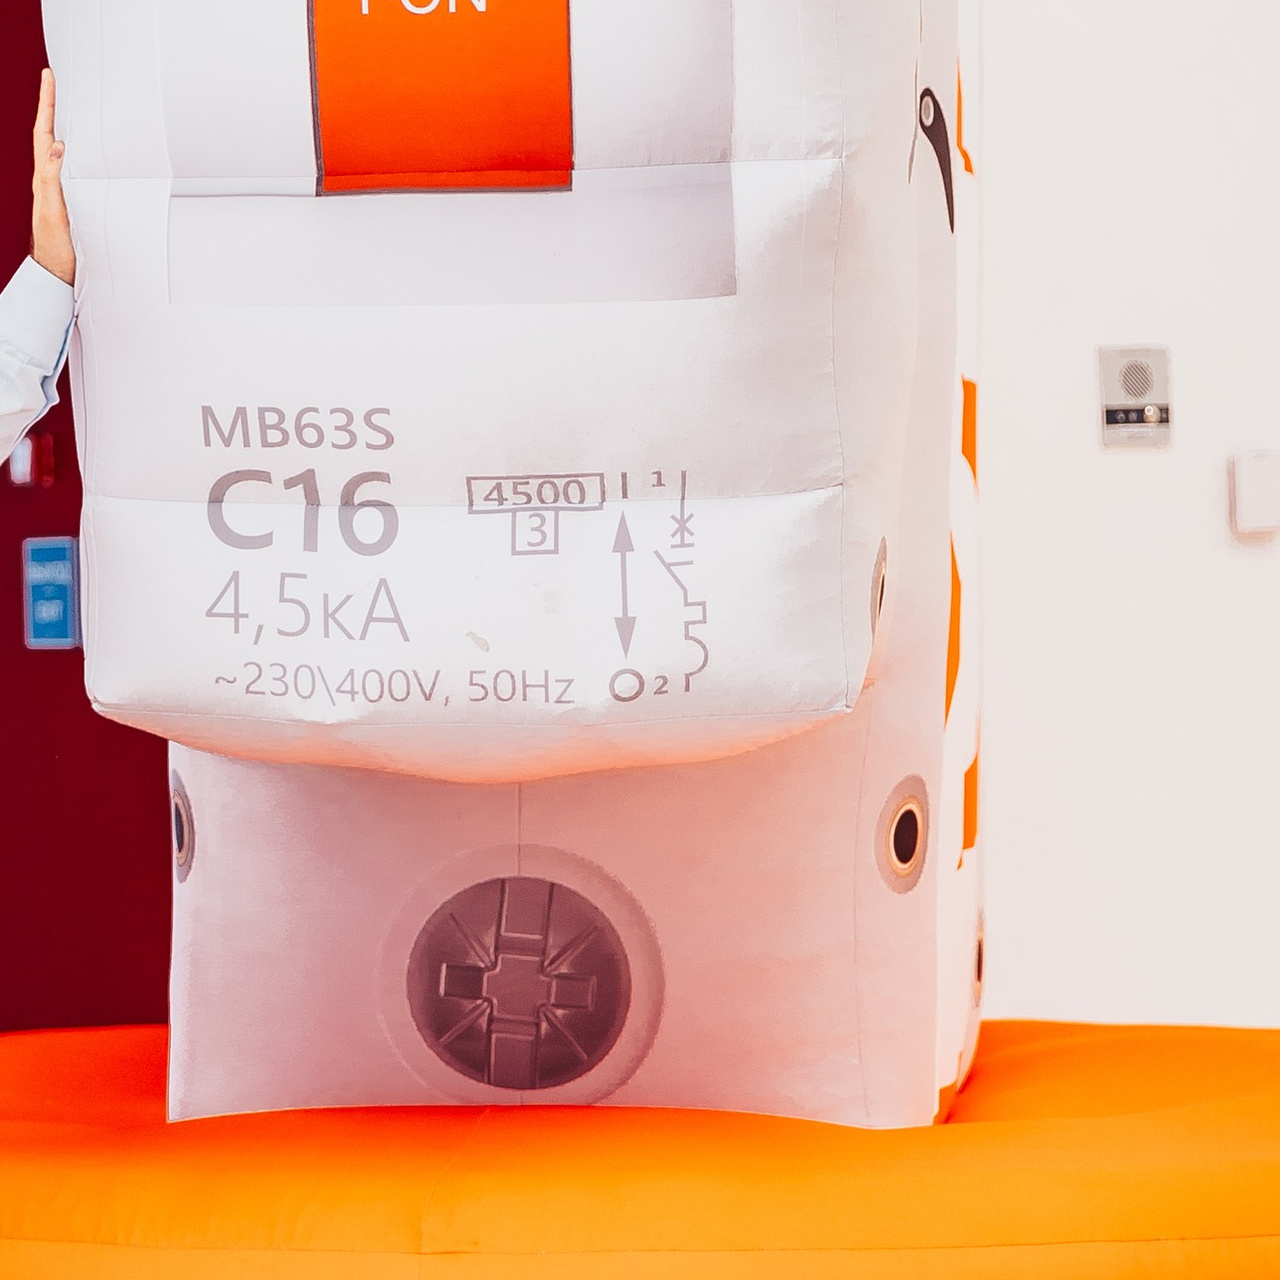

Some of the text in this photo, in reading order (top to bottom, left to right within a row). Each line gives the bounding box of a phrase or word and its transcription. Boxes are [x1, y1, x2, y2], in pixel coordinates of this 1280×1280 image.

[200, 405, 395, 451] MB63S
[483, 479, 586, 507] 4500
[206, 468, 400, 557] C16
[526, 512, 548, 548] 3
[468, 669, 576, 705] 50Hz
